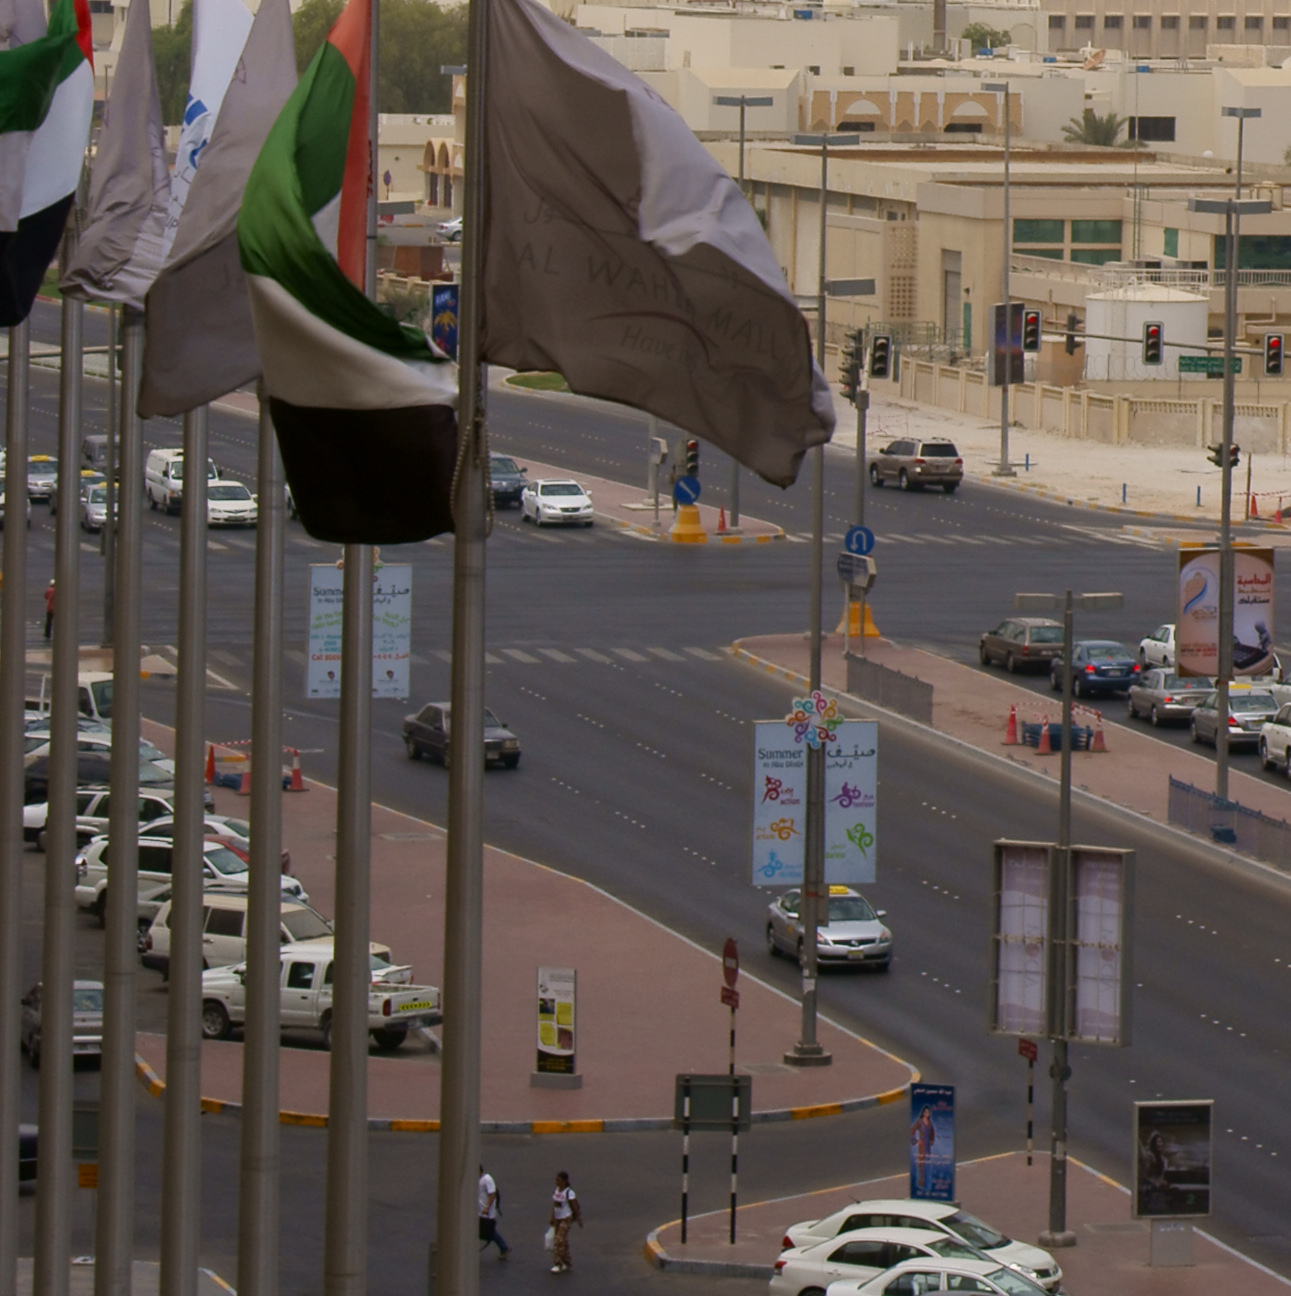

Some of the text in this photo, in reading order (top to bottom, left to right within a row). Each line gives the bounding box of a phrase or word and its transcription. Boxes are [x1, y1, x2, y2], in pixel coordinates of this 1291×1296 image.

[518, 241, 560, 277] AL
[704, 307, 781, 361] MALL
[620, 323, 674, 360] Have
[313, 586, 344, 597] Summ
[758, 747, 804, 760] Summer
